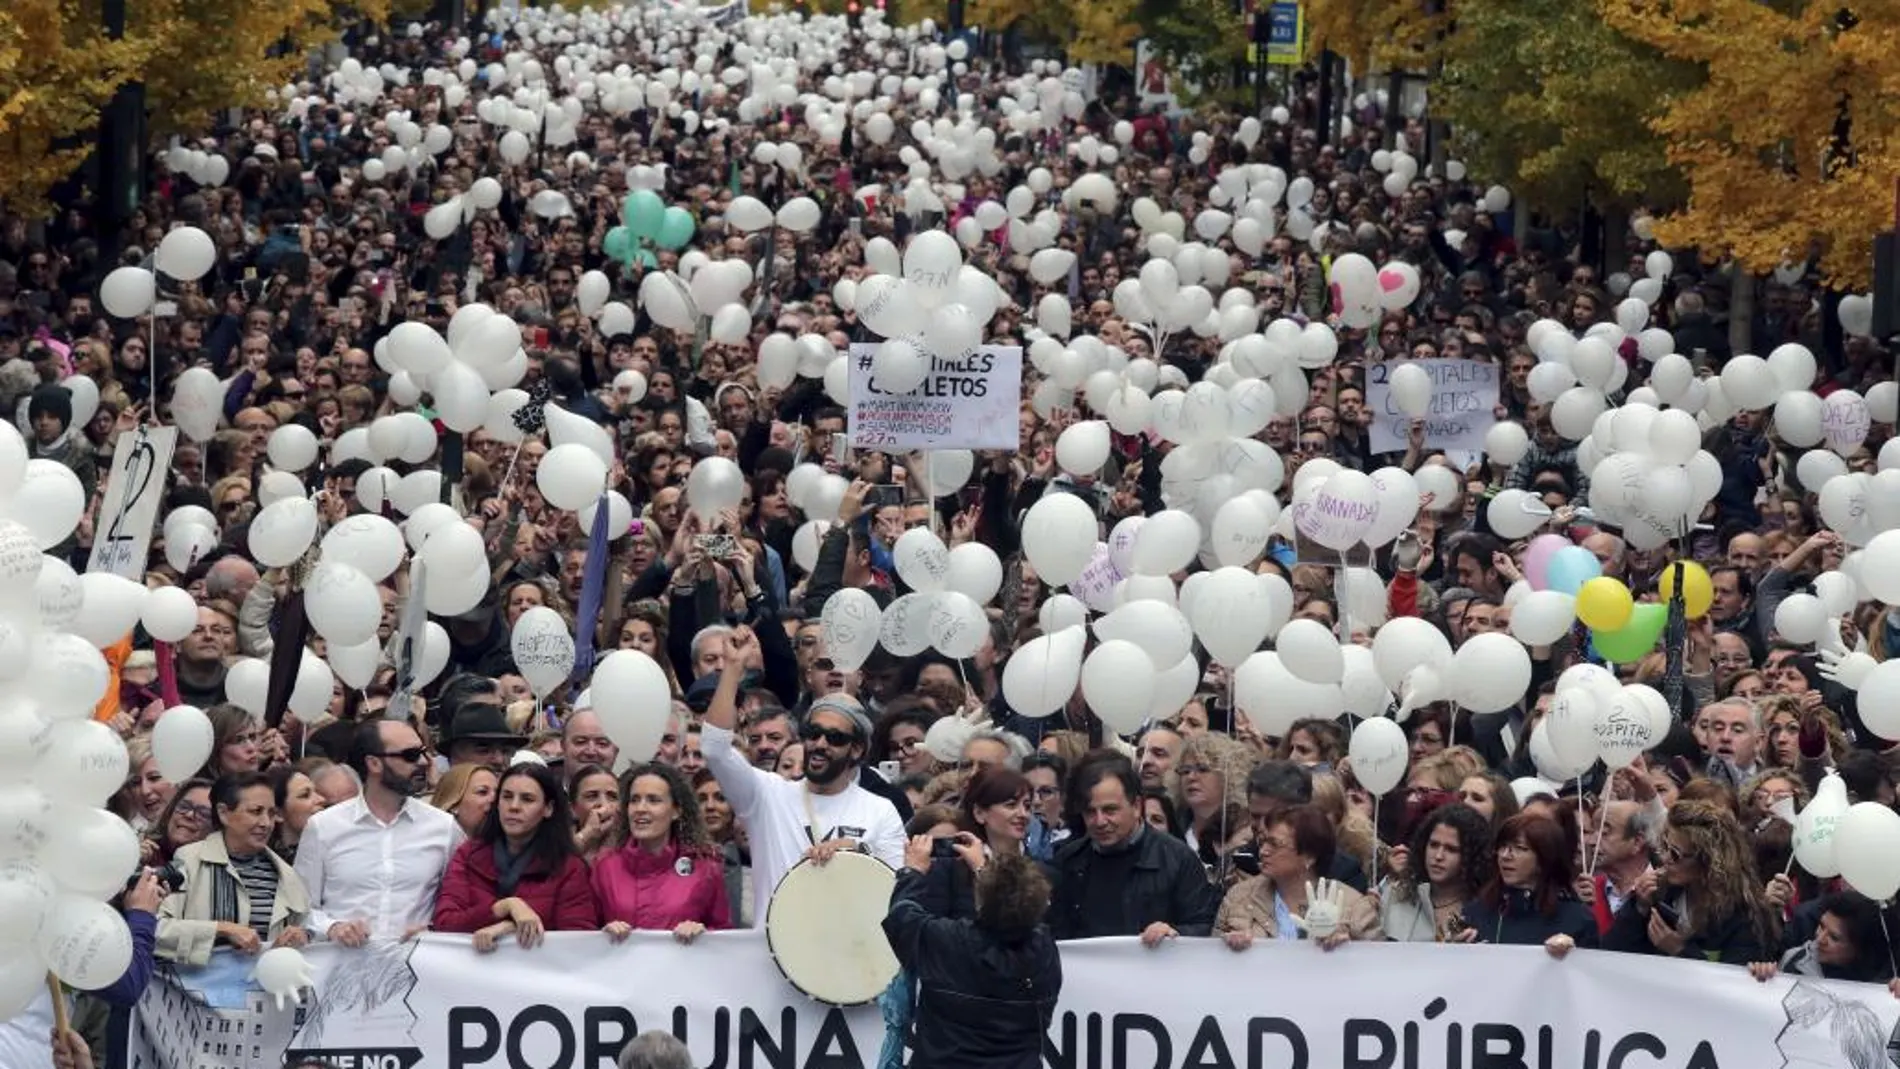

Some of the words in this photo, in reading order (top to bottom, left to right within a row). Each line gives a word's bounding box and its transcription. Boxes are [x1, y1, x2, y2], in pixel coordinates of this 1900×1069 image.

[858, 353, 996, 373] #ITALES
[1371, 363, 1389, 385] 2
[1425, 362, 1493, 385] PITALES
[867, 376, 988, 397] CLETOS
[1385, 391, 1481, 416] CLETOS
[107, 441, 156, 542] 2
[1042, 1010, 1310, 1069] NIDAD
